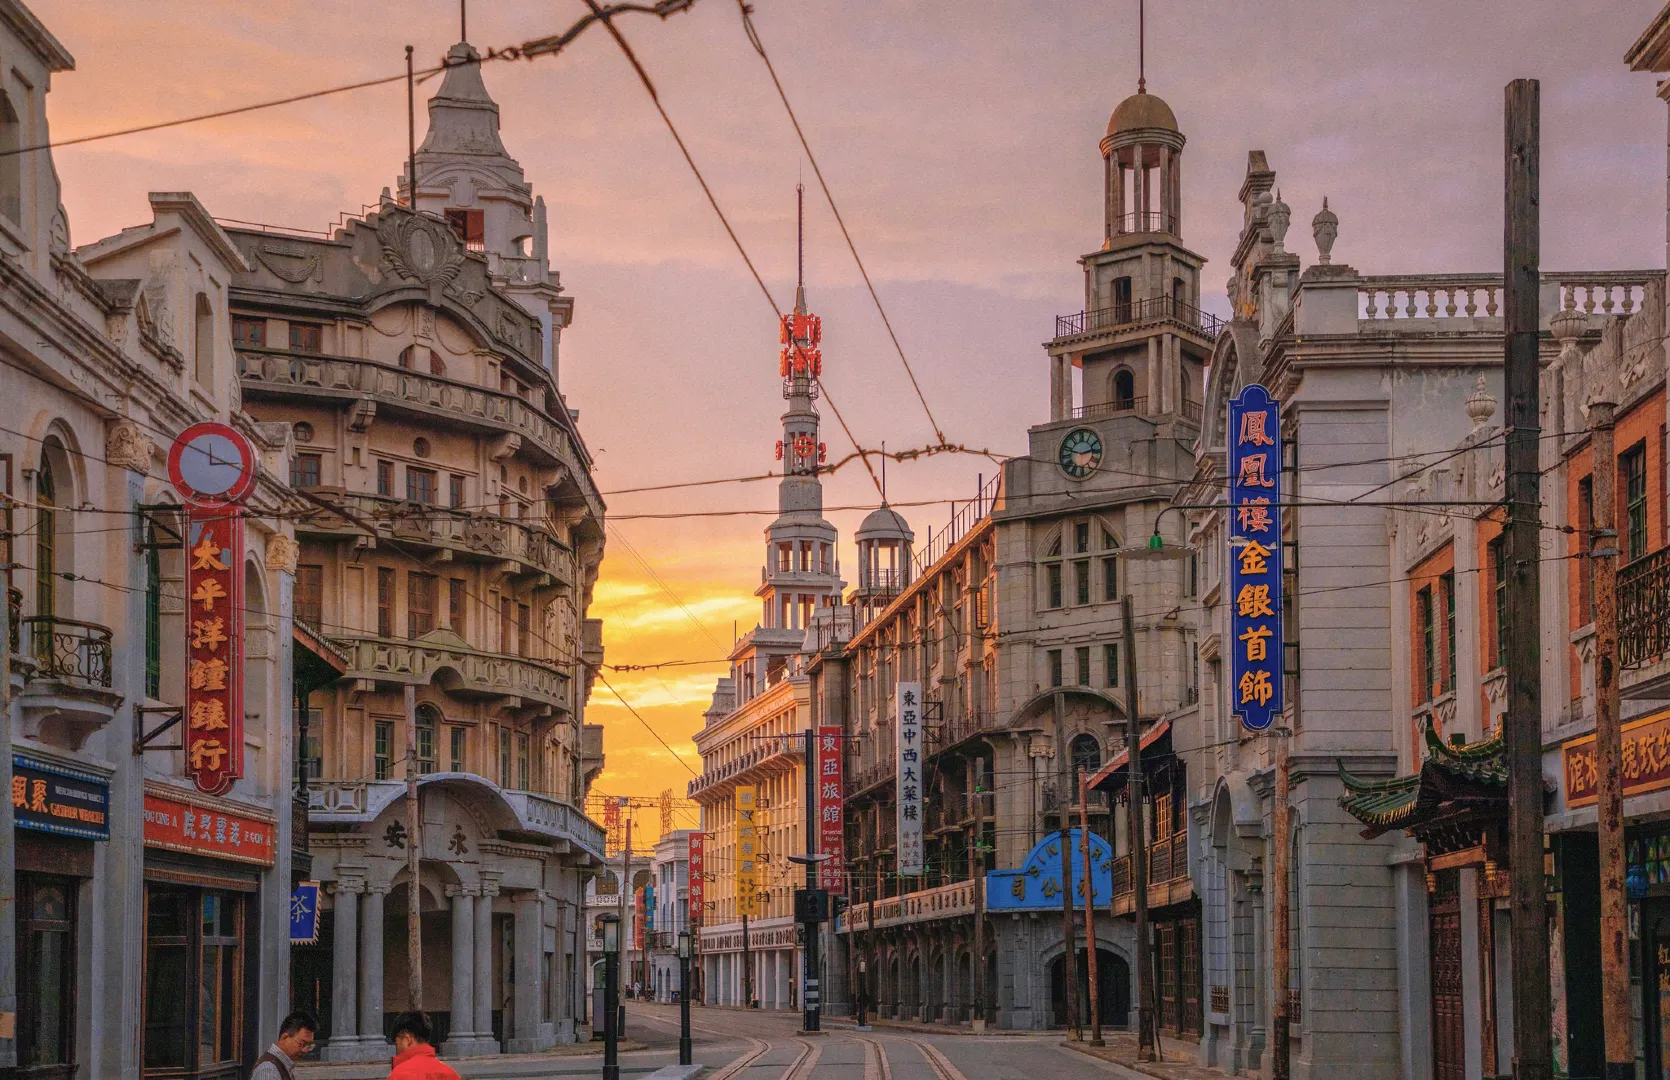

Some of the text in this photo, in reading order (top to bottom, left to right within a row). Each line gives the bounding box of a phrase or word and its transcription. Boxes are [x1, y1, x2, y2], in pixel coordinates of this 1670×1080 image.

[1236, 410, 1274, 708] 鳳凰樓金銀首飾
[821, 734, 841, 823] 東亞旅館
[290, 895, 312, 924] 茶
